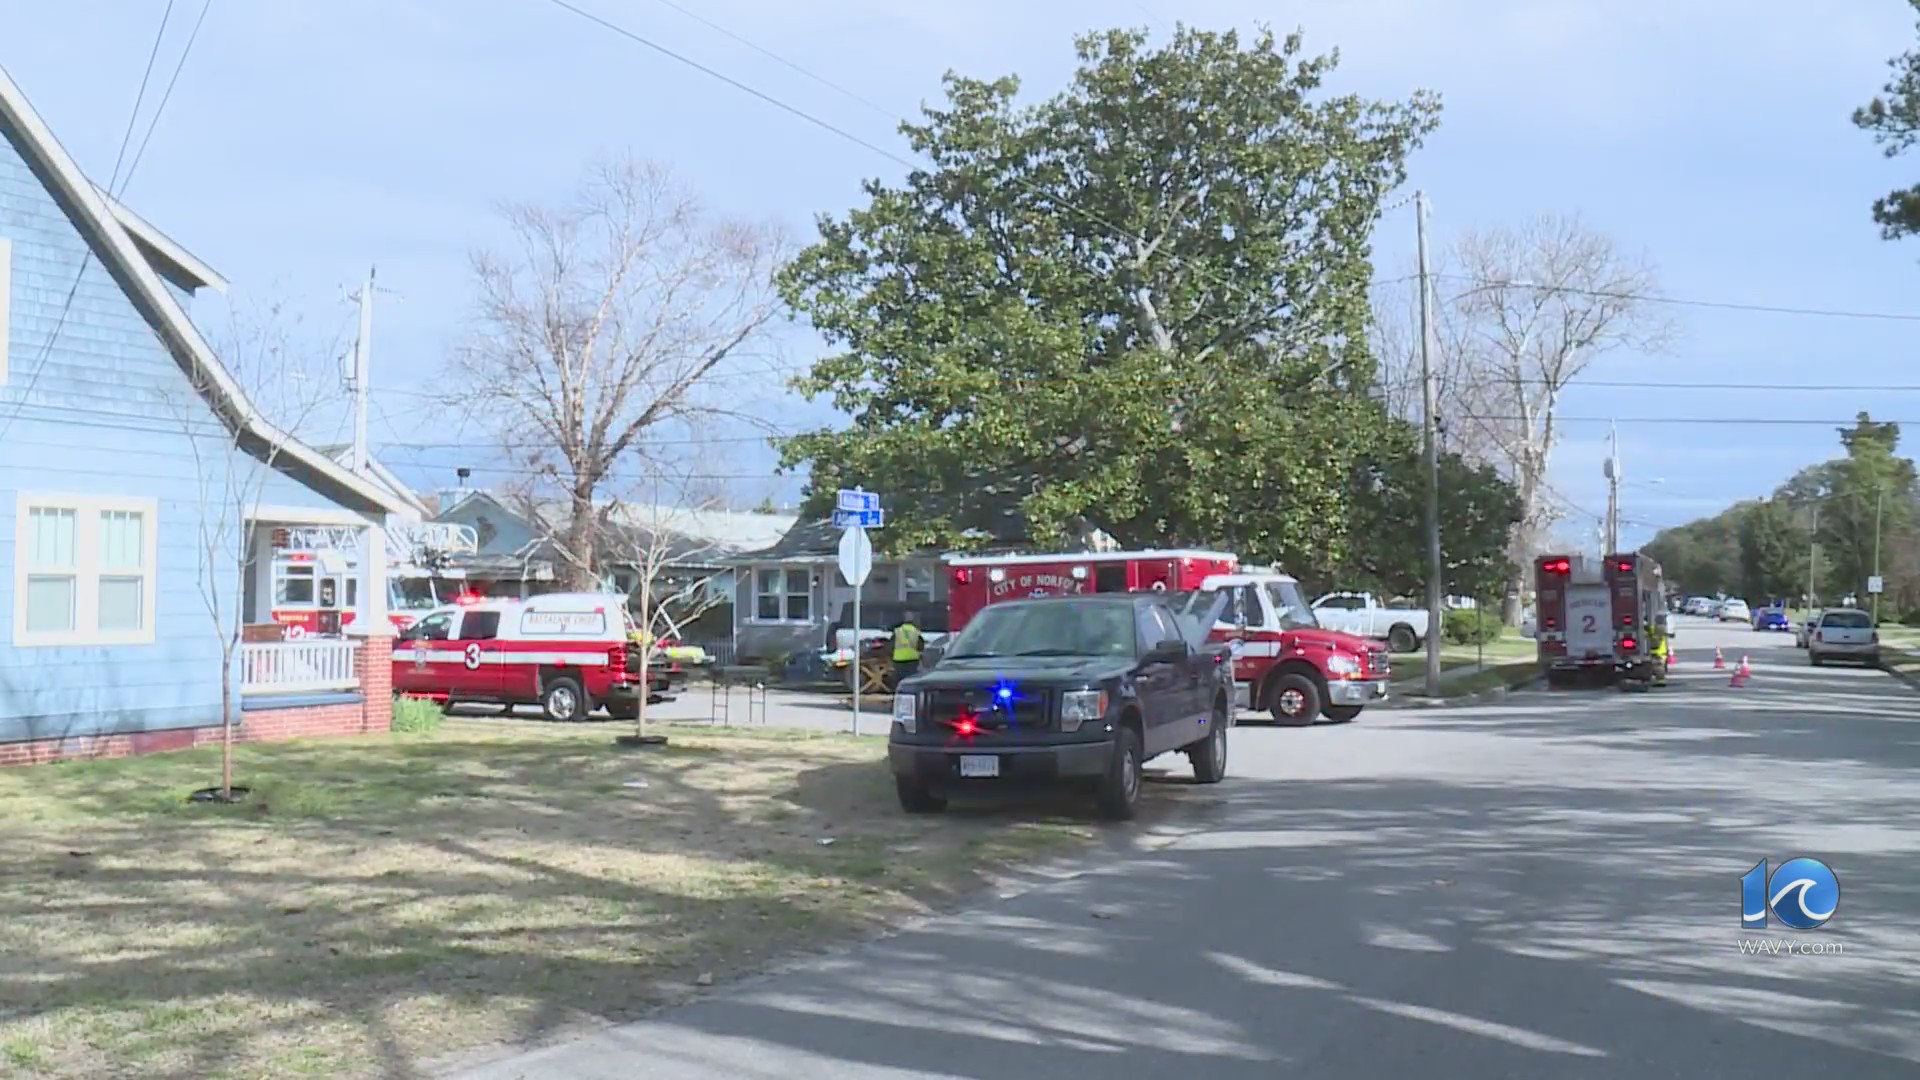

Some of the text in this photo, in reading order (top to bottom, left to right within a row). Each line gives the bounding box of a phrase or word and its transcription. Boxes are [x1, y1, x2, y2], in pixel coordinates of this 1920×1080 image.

[994, 575, 1084, 596] CITY OF NORFOLK
[1582, 615, 1596, 633] 2
[465, 642, 481, 671] 3
